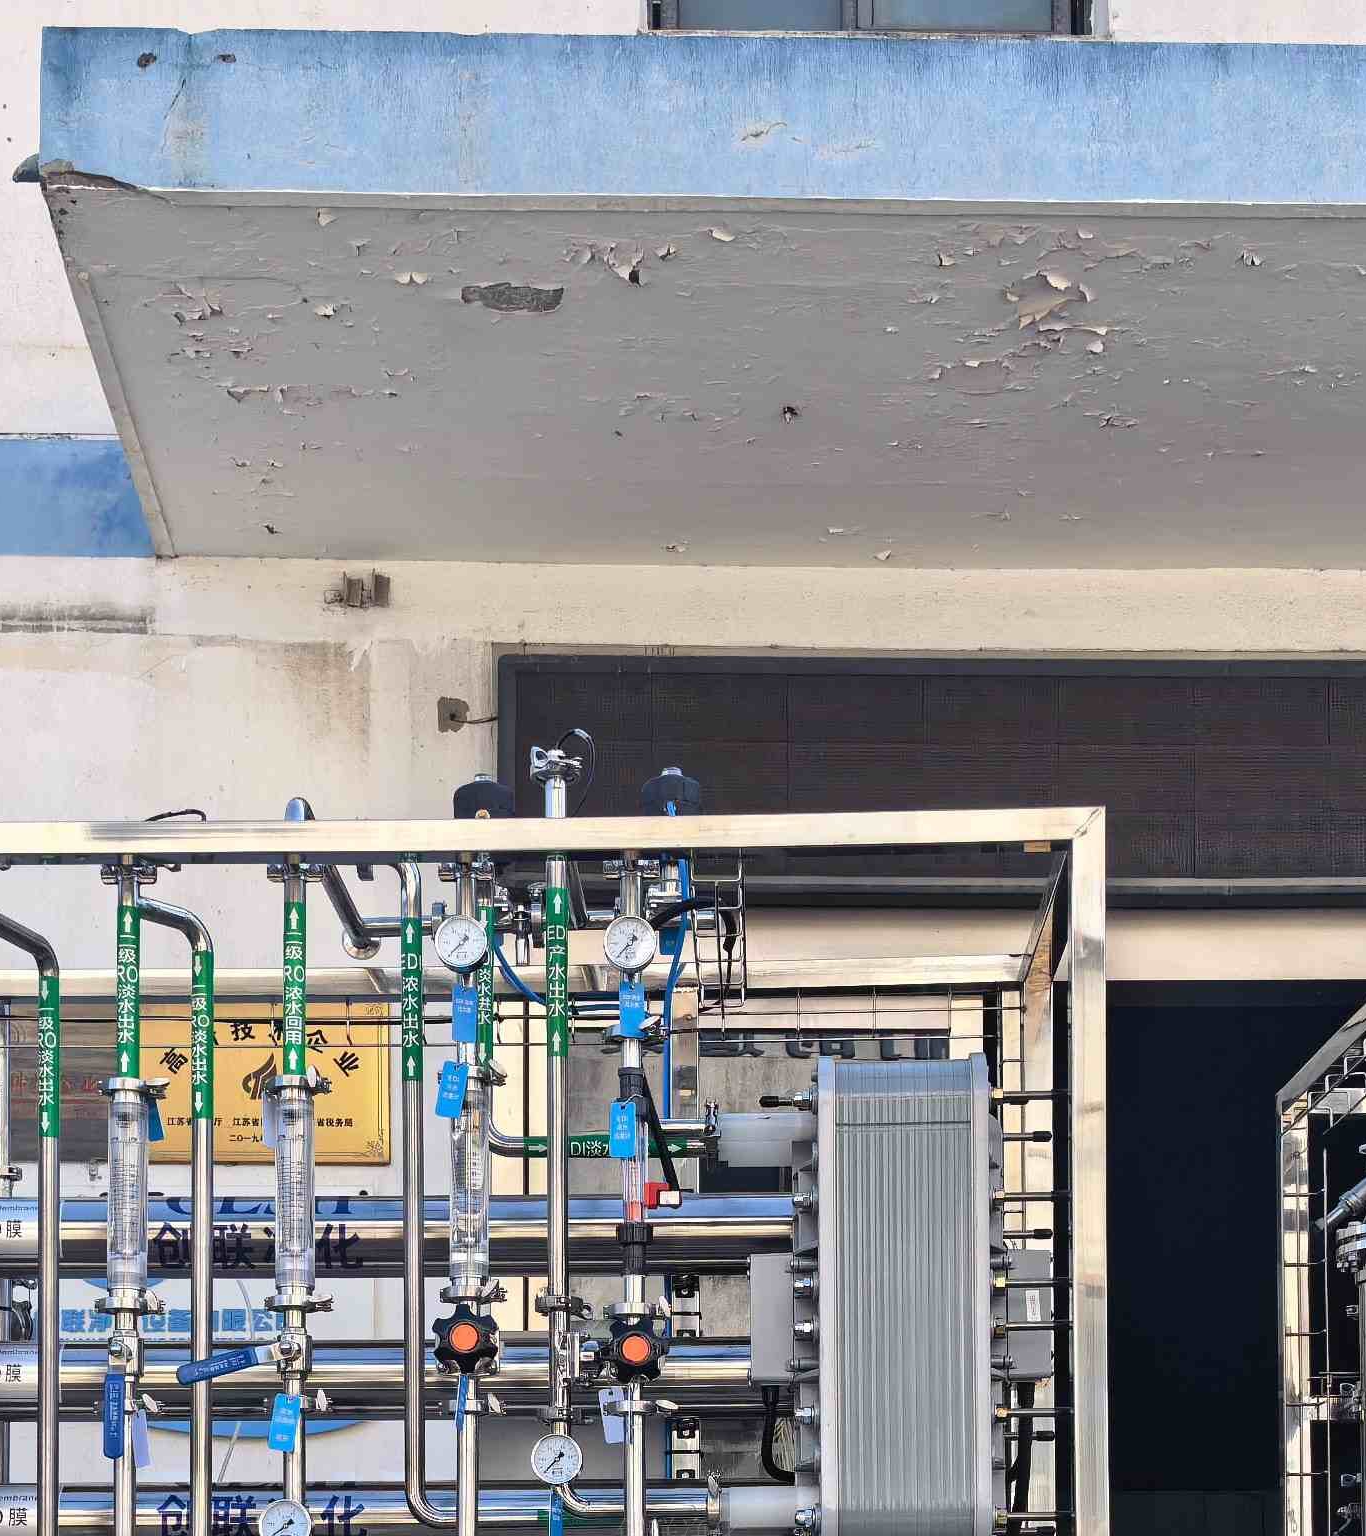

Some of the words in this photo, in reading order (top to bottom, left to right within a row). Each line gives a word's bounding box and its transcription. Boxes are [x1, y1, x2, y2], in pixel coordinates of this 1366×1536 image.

[117, 934, 138, 1044] 二级RO淡水出水
[283, 931, 305, 1045] 二级RO浓水回用
[152, 1221, 364, 1269] 创联化
